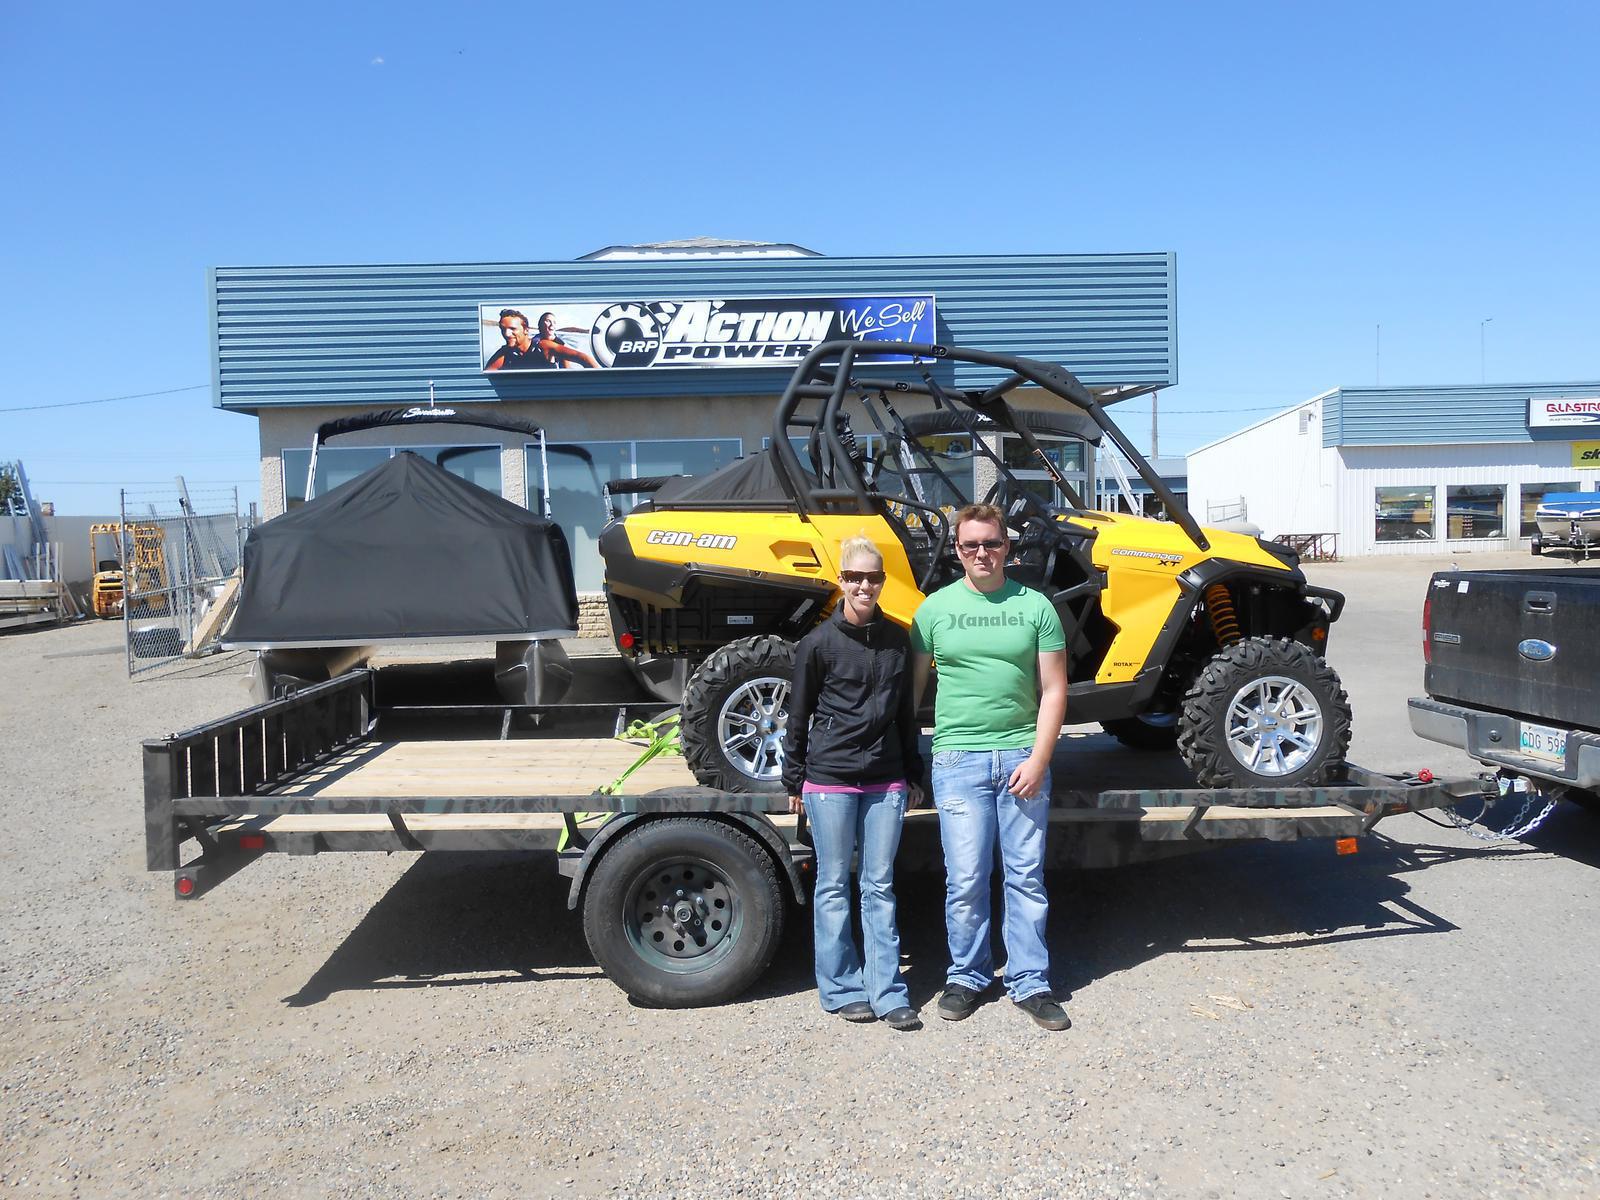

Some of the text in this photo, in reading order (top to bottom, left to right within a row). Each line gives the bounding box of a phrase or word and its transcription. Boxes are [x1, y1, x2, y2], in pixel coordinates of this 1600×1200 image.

[663, 300, 834, 343] ACTION
[840, 300, 926, 333] We Sell
[619, 341, 658, 353] BRP
[646, 530, 737, 550] can-am
[1522, 732, 1541, 749] CDG
